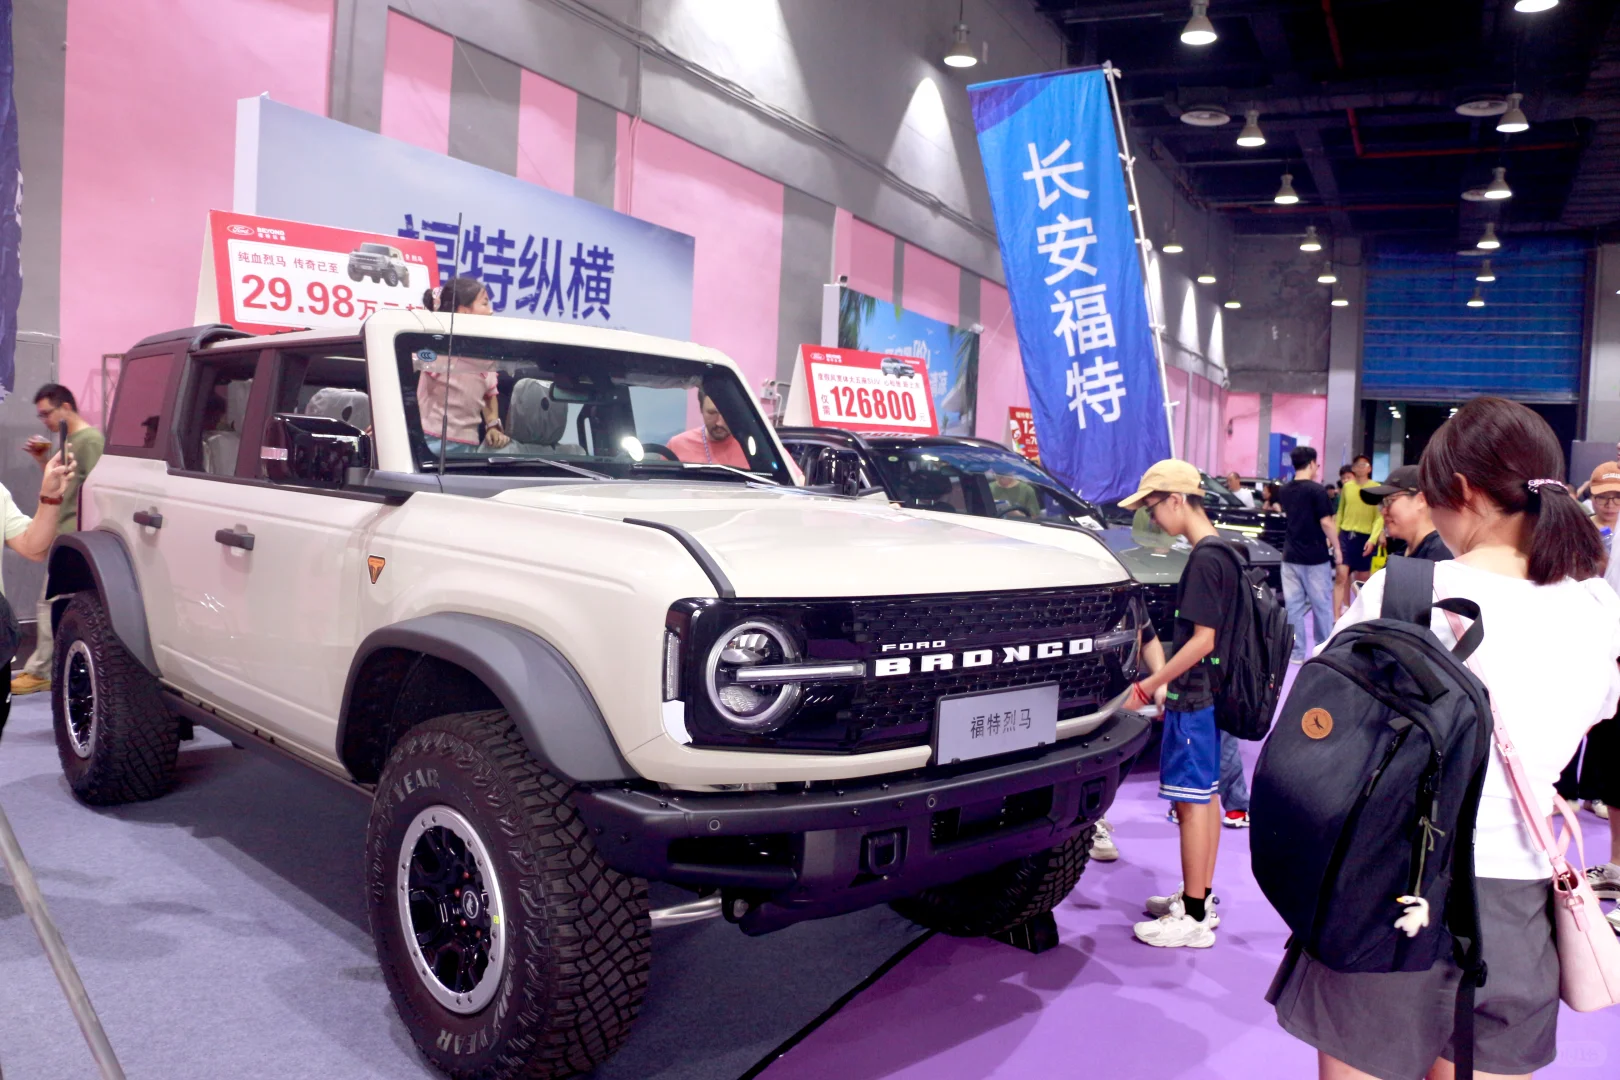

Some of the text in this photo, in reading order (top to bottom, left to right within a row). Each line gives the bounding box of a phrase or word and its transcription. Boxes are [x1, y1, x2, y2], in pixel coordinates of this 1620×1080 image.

[238, 251, 286, 267] 纯血烈马
[1023, 139, 1126, 430] 长安福特
[830, 386, 916, 422] 126800
[875, 638, 1093, 677] BRONCO
[882, 640, 946, 652] FORD
[970, 708, 1032, 740] 福特烈马
